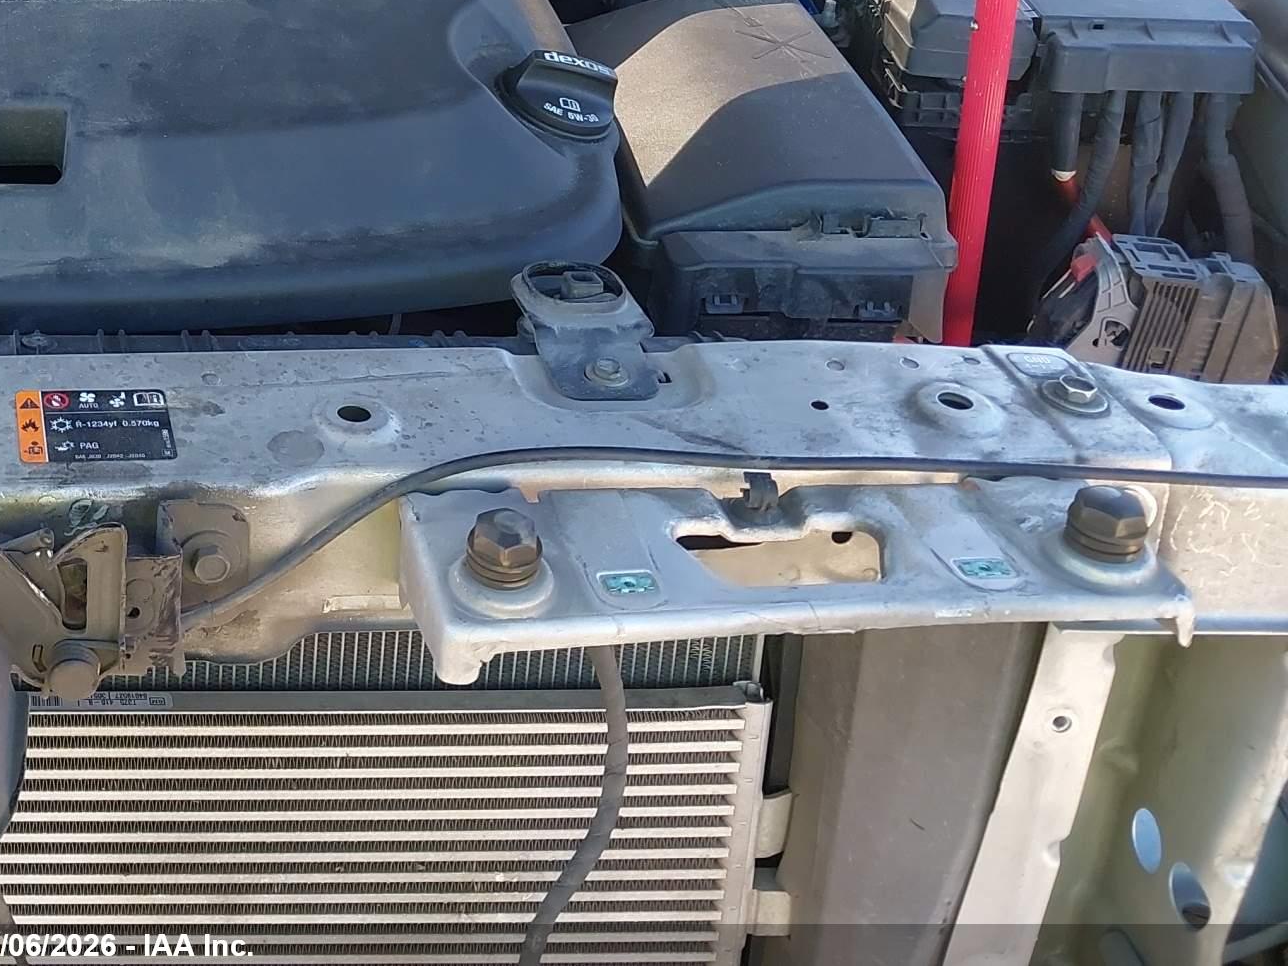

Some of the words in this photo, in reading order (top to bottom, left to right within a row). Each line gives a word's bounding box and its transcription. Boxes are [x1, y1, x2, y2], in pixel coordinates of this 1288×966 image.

[543, 51, 610, 75] dexos
[543, 102, 564, 116] SAE
[567, 112, 600, 123] 5W-30
[75, 419, 118, 429] R-1234yf
[80, 441, 99, 449] PAG
